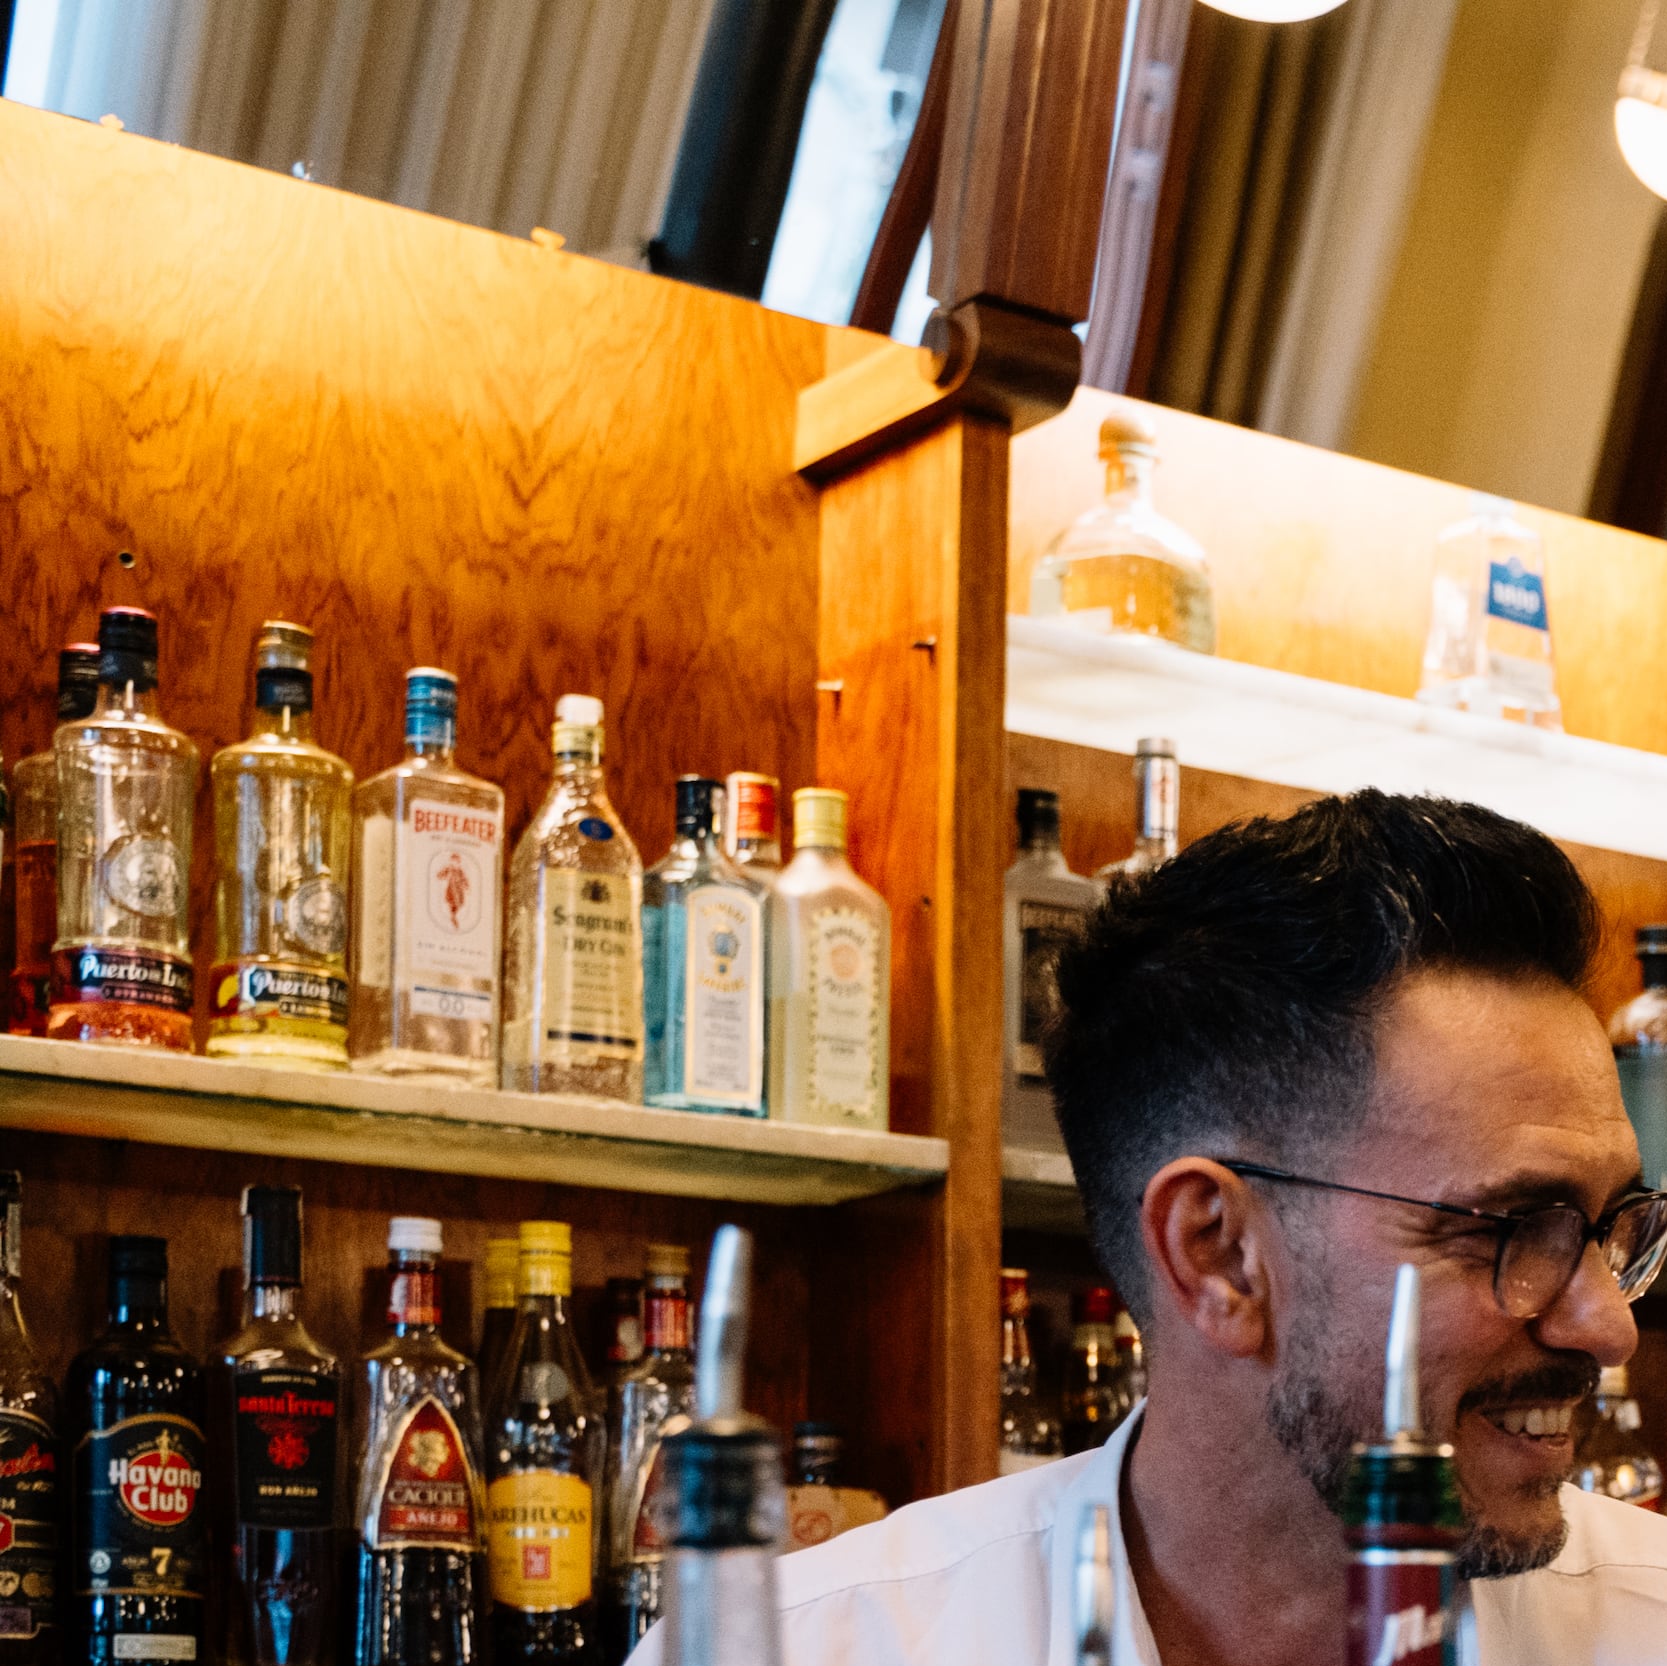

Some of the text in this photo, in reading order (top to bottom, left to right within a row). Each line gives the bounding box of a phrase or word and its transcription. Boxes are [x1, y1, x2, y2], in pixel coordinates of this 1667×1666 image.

[414, 810, 497, 842] BEEFEATER
[80, 954, 148, 982] Puerto
[252, 970, 320, 998] Puerto
[108, 1458, 202, 1490] Havana
[131, 1486, 188, 1514] Club
[388, 1486, 466, 1507] CACIQUE
[152, 1547, 172, 1576] 7
